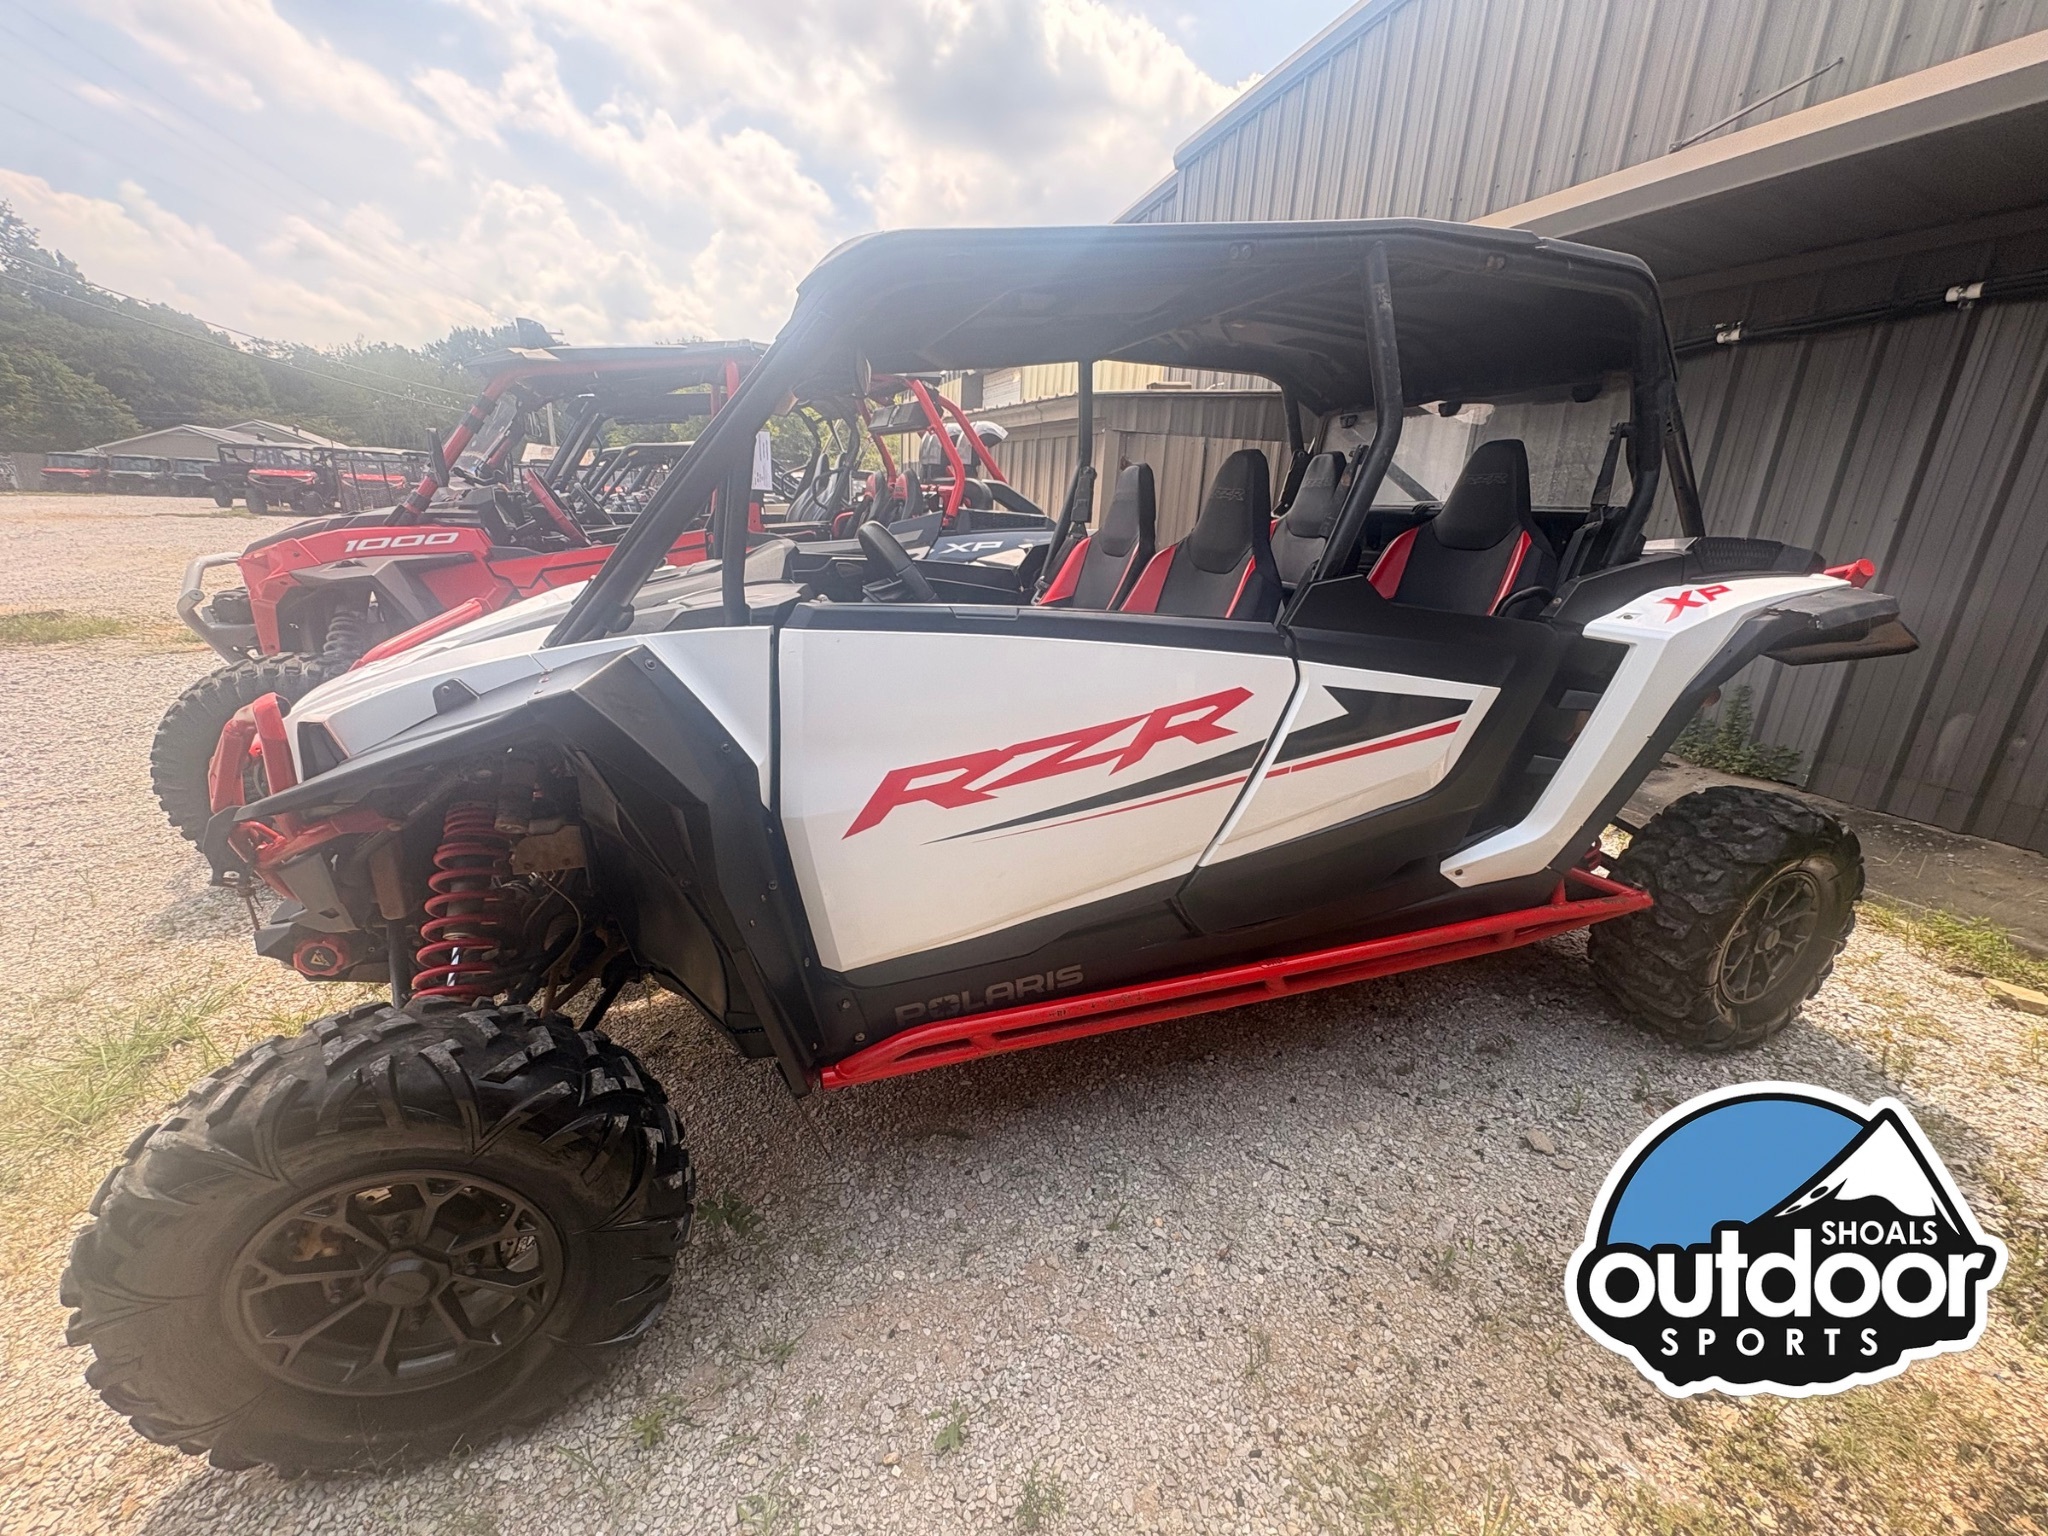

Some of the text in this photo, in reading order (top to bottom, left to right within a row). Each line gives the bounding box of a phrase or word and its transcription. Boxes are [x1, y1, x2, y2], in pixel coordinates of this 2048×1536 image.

[344, 532, 459, 553] 1000
[938, 540, 1004, 555] XP
[1655, 584, 1733, 624] XP
[842, 686, 1254, 840] RZR
[894, 964, 1084, 1026] POLARIS
